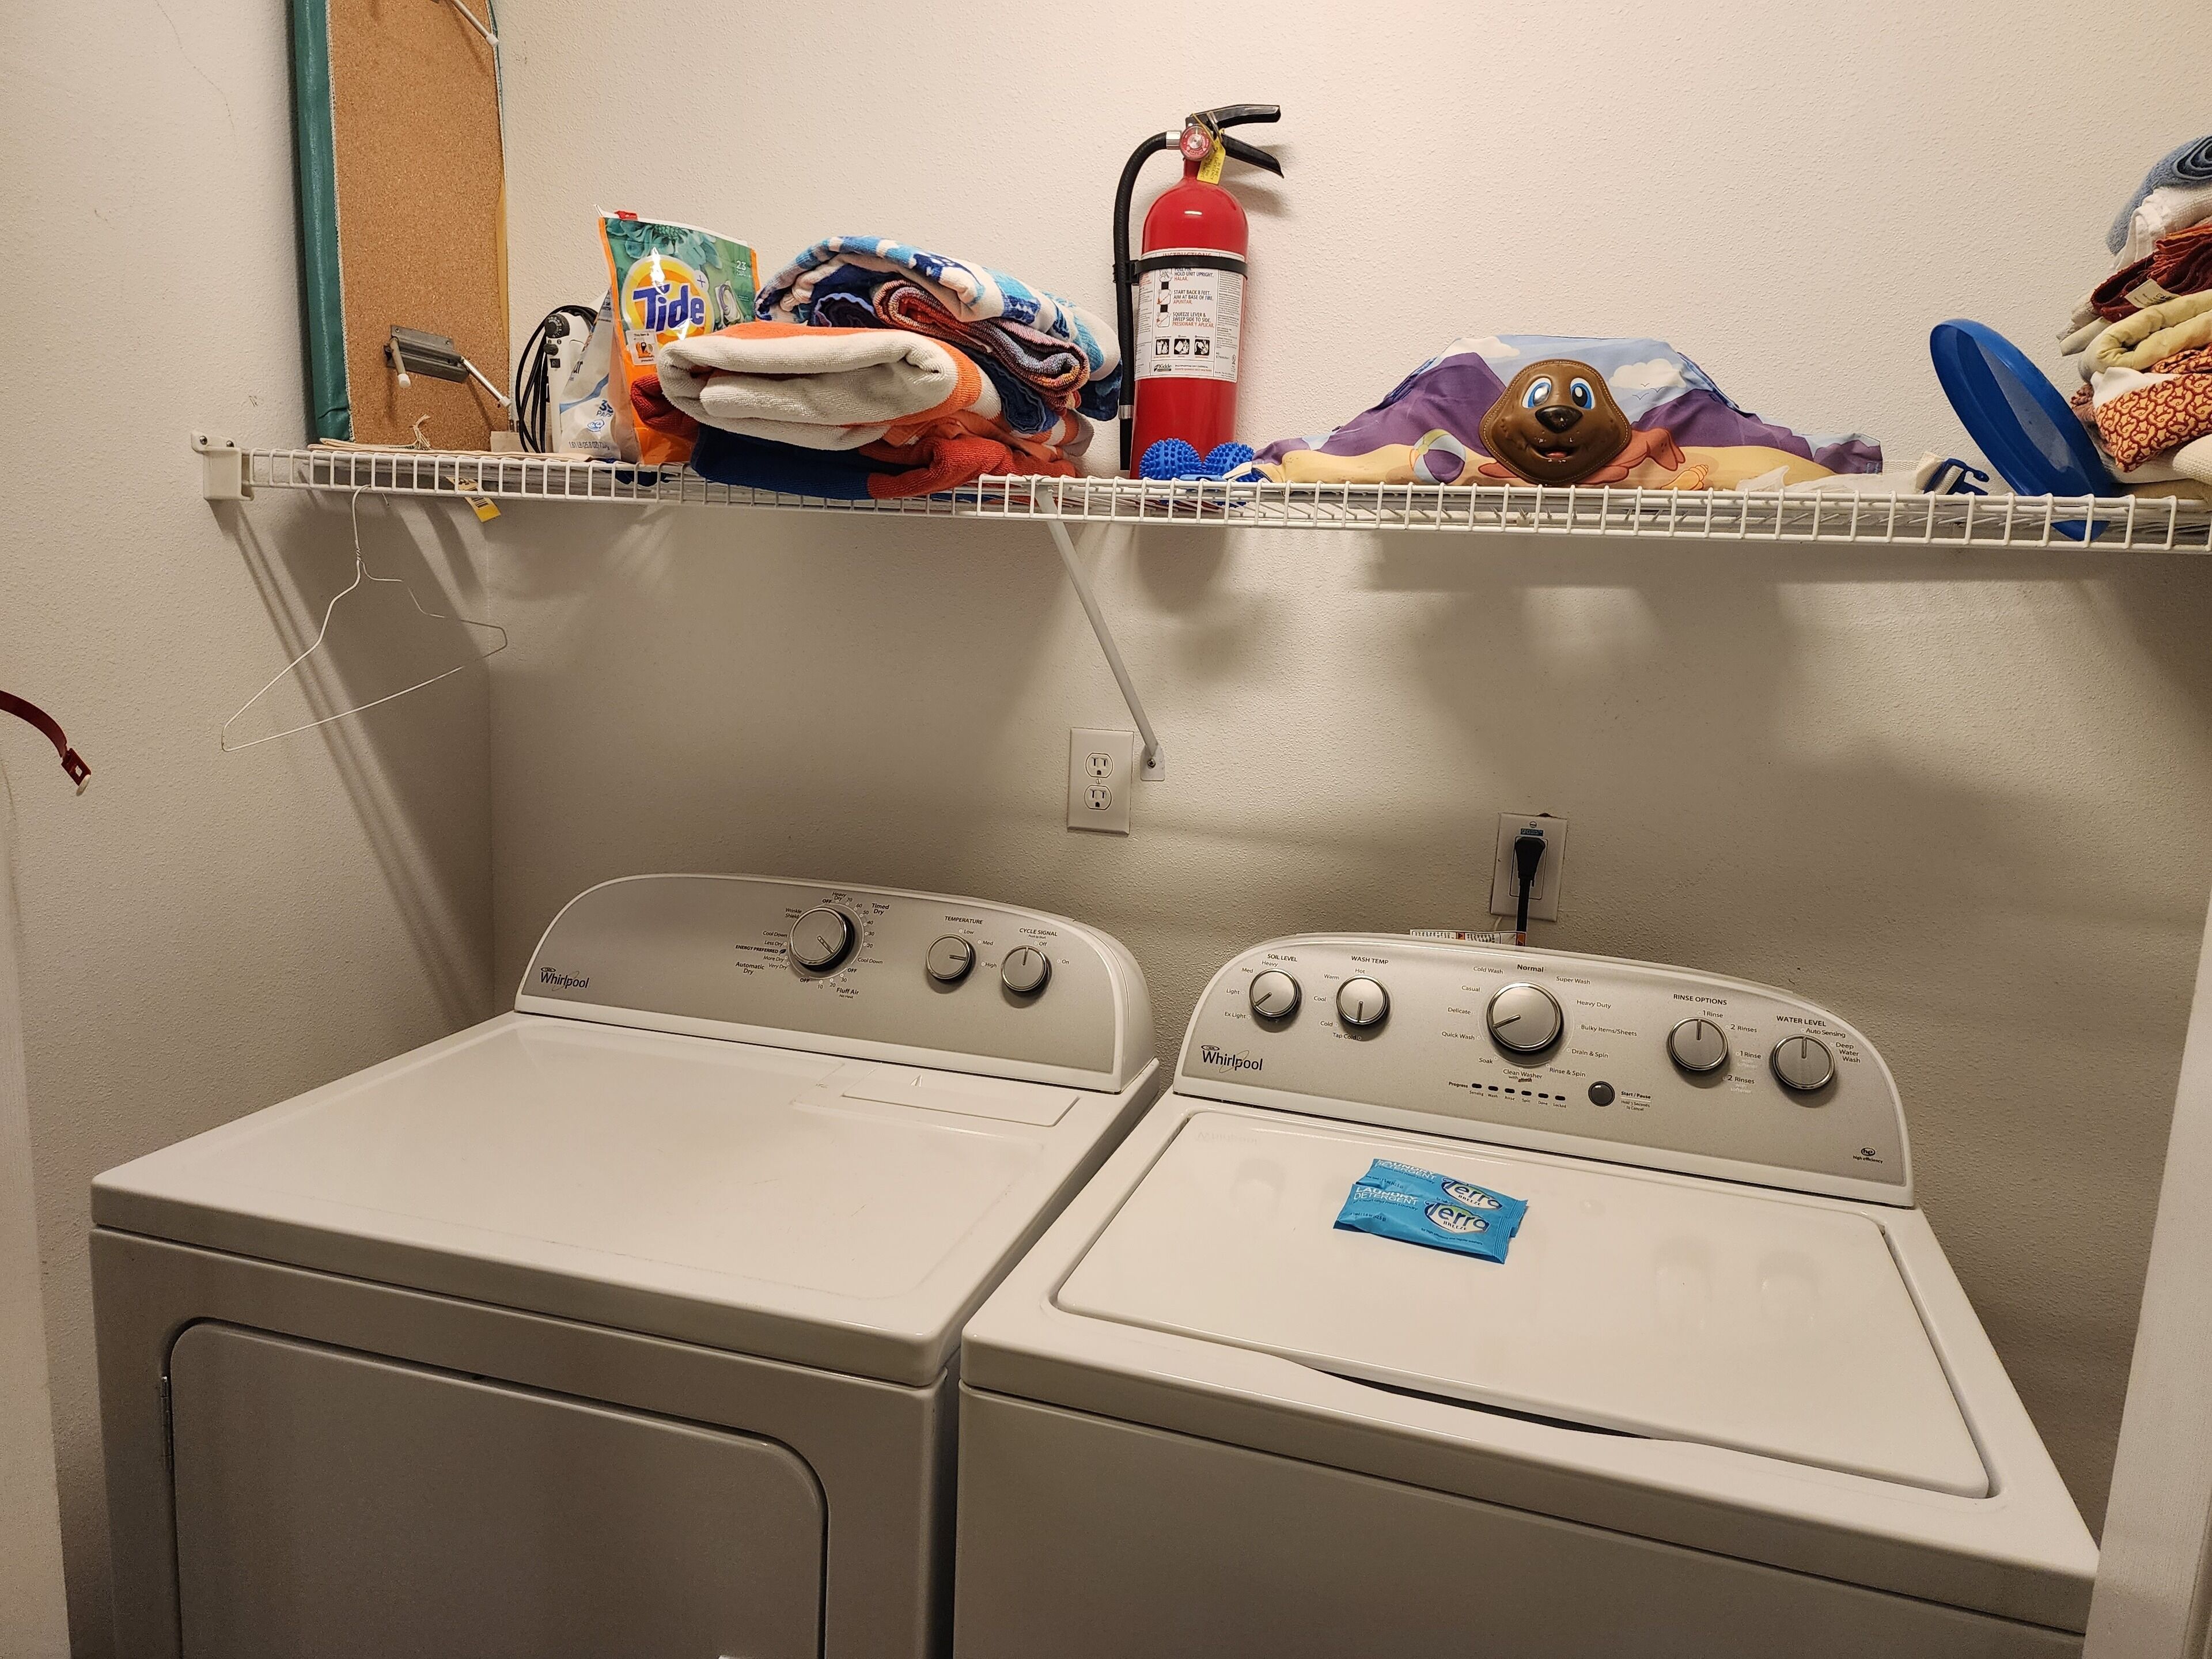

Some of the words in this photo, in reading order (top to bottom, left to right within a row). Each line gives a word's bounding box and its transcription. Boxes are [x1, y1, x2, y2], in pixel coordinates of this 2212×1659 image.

[736, 260, 747, 271] 23
[634, 284, 704, 332] Tide
[945, 916, 983, 925] TEMPERATURE
[1351, 955, 1369, 963] WASH
[736, 961, 764, 970] Automatic
[1262, 960, 1278, 968] Heavy
[1517, 964, 1544, 972] Normal
[541, 971, 590, 988] Whirlpool
[1556, 976, 1573, 984] Super
[1577, 999, 1595, 1008] Heavy
[1673, 994, 1694, 1002] RINSE
[1695, 997, 1728, 1005] OPTIONS
[1448, 1007, 1471, 1015] Delicate
[1231, 1012, 1247, 1020] Light
[1777, 1016, 1802, 1025] WATER
[1804, 1018, 1827, 1027] LEVEL
[1581, 1024, 1597, 1033] Bulky
[1598, 1027, 1637, 1036] Items/Sheets
[1737, 1025, 1757, 1033] Rinses
[1821, 1030, 1846, 1038] Sensing
[1571, 1048, 1588, 1056] Drain
[1202, 1049, 1263, 1071] Whirlpool
[1549, 1067, 1566, 1075] Rinse
[1734, 1076, 1755, 1085] Rinses
[1356, 1187, 1418, 1200] LAUNDRY
[1442, 1177, 1503, 1210] Terra
[1353, 1192, 1418, 1205] DETERGENT
[1425, 1200, 1490, 1232] Terra
